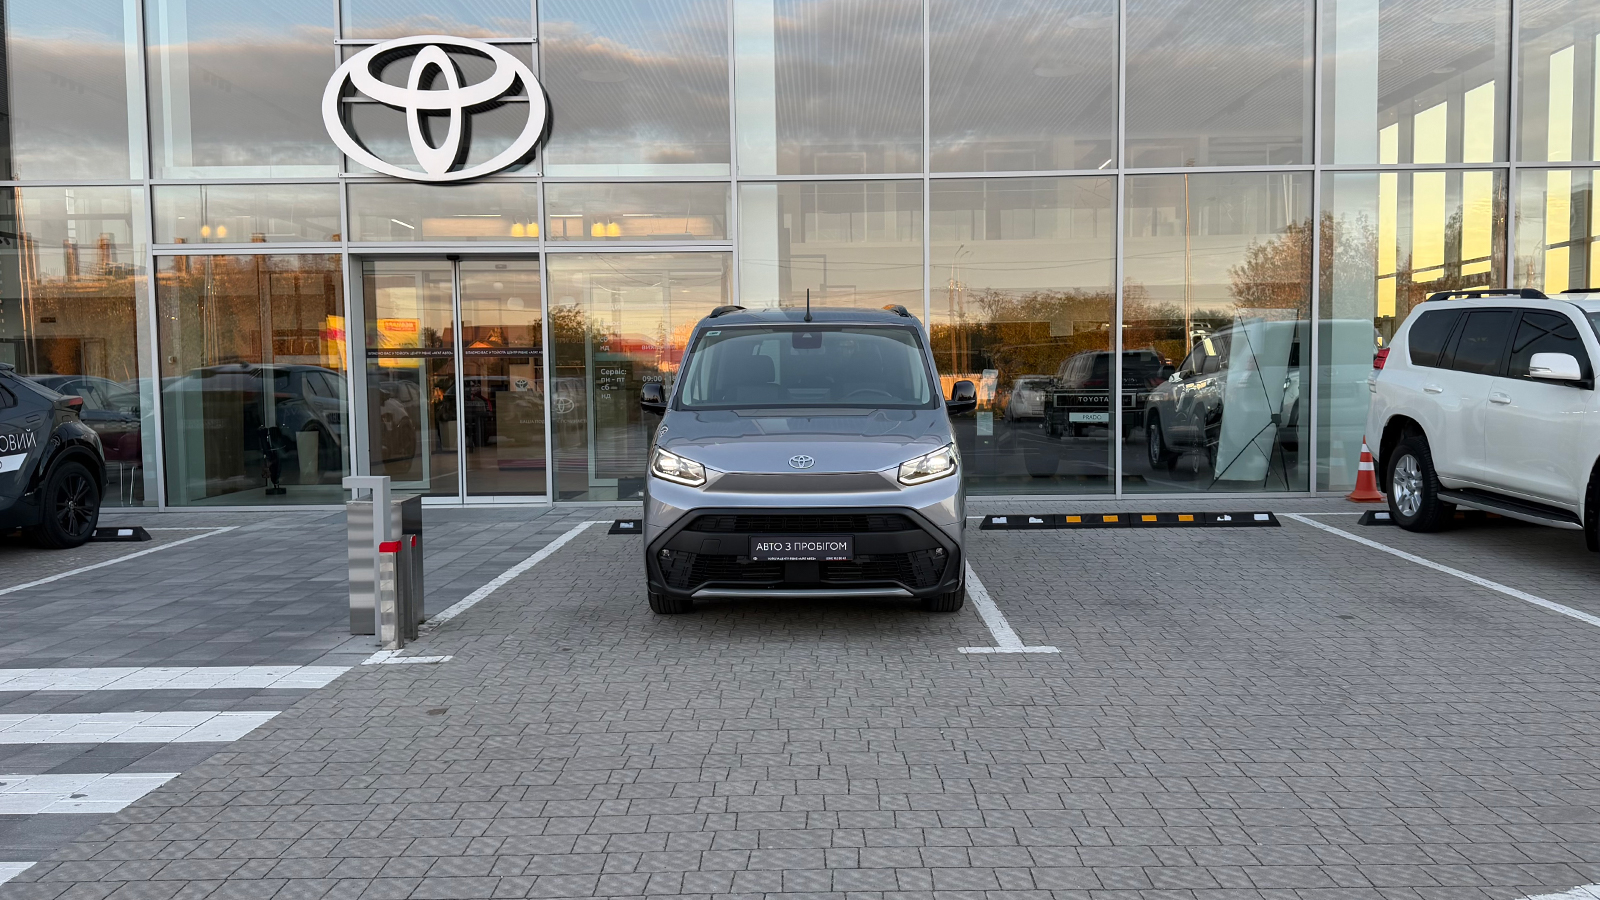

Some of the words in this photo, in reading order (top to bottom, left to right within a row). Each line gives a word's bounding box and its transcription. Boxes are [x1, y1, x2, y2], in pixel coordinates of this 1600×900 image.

[756, 542, 782, 550] АВТО
[785, 542, 792, 550] З
[794, 542, 847, 550] ПРОБІГОМ
